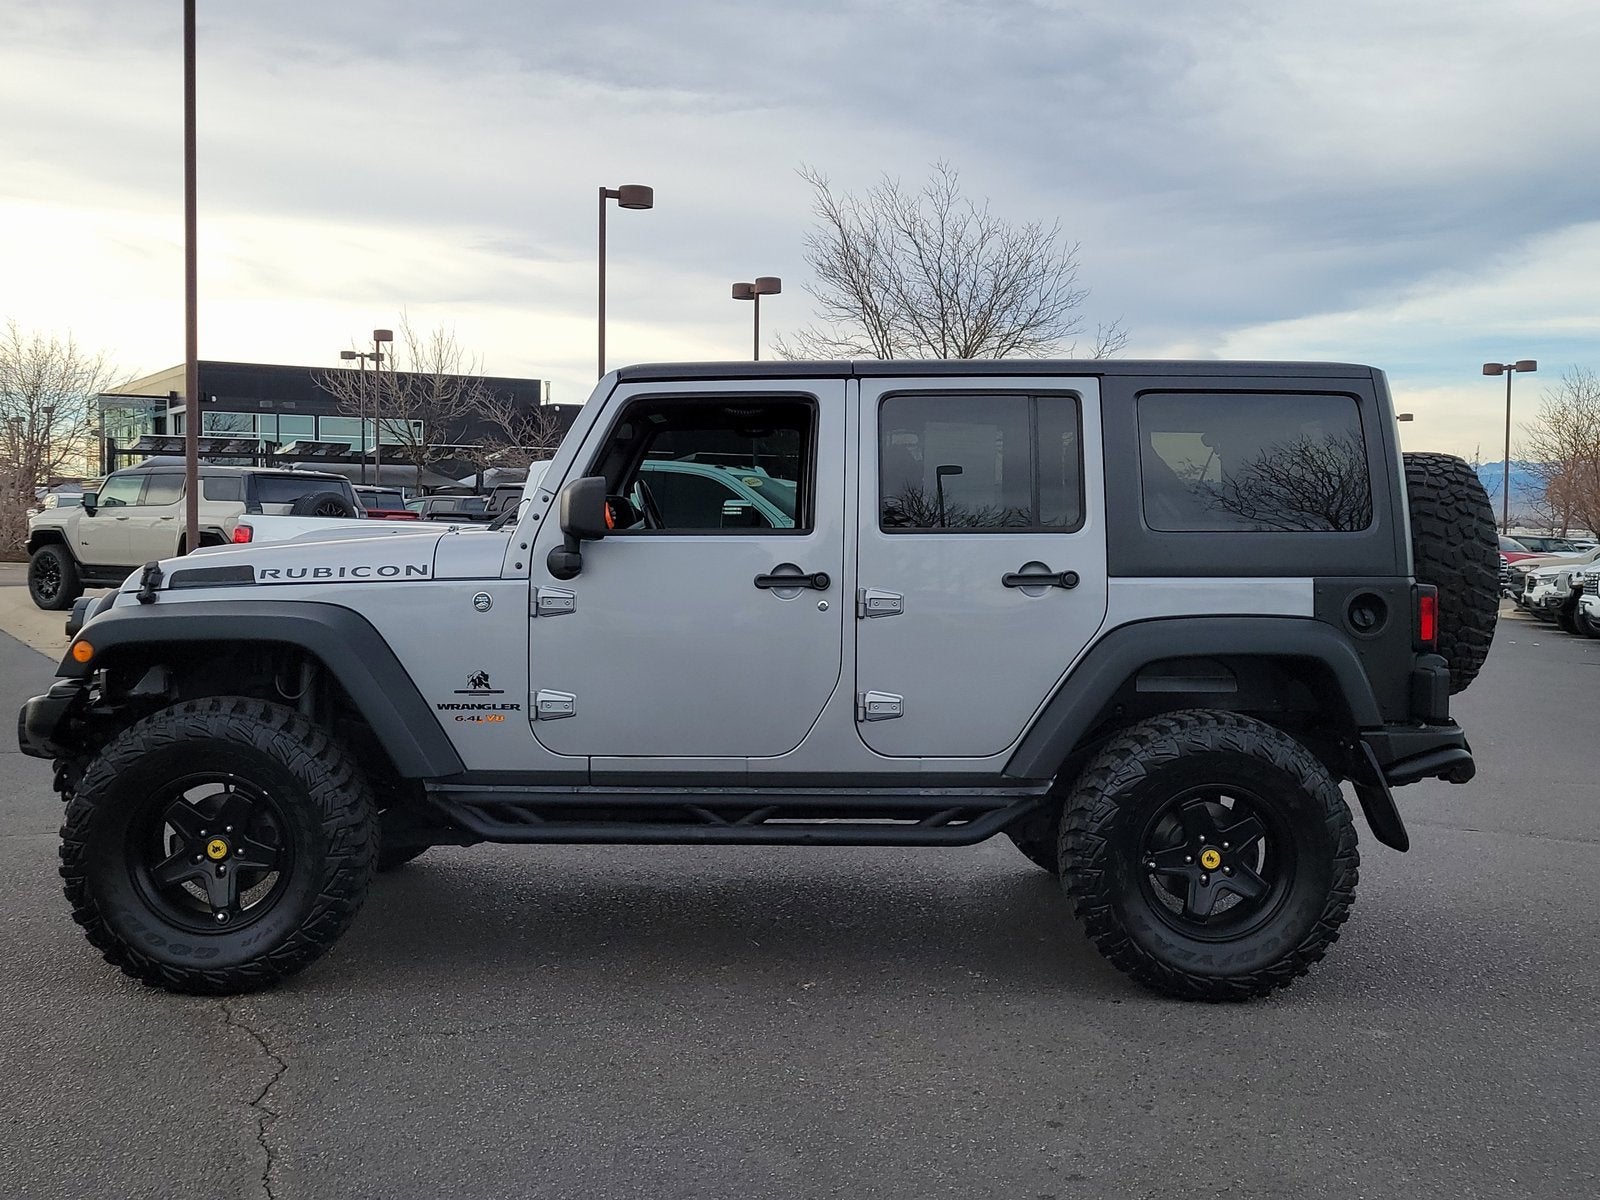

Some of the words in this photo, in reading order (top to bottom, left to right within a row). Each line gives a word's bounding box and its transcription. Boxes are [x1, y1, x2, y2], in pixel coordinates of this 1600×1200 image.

[259, 564, 428, 580] RUBICON
[436, 703, 521, 711] WRANGLER
[454, 715, 483, 723] 6.4L
[486, 714, 505, 722] V8
